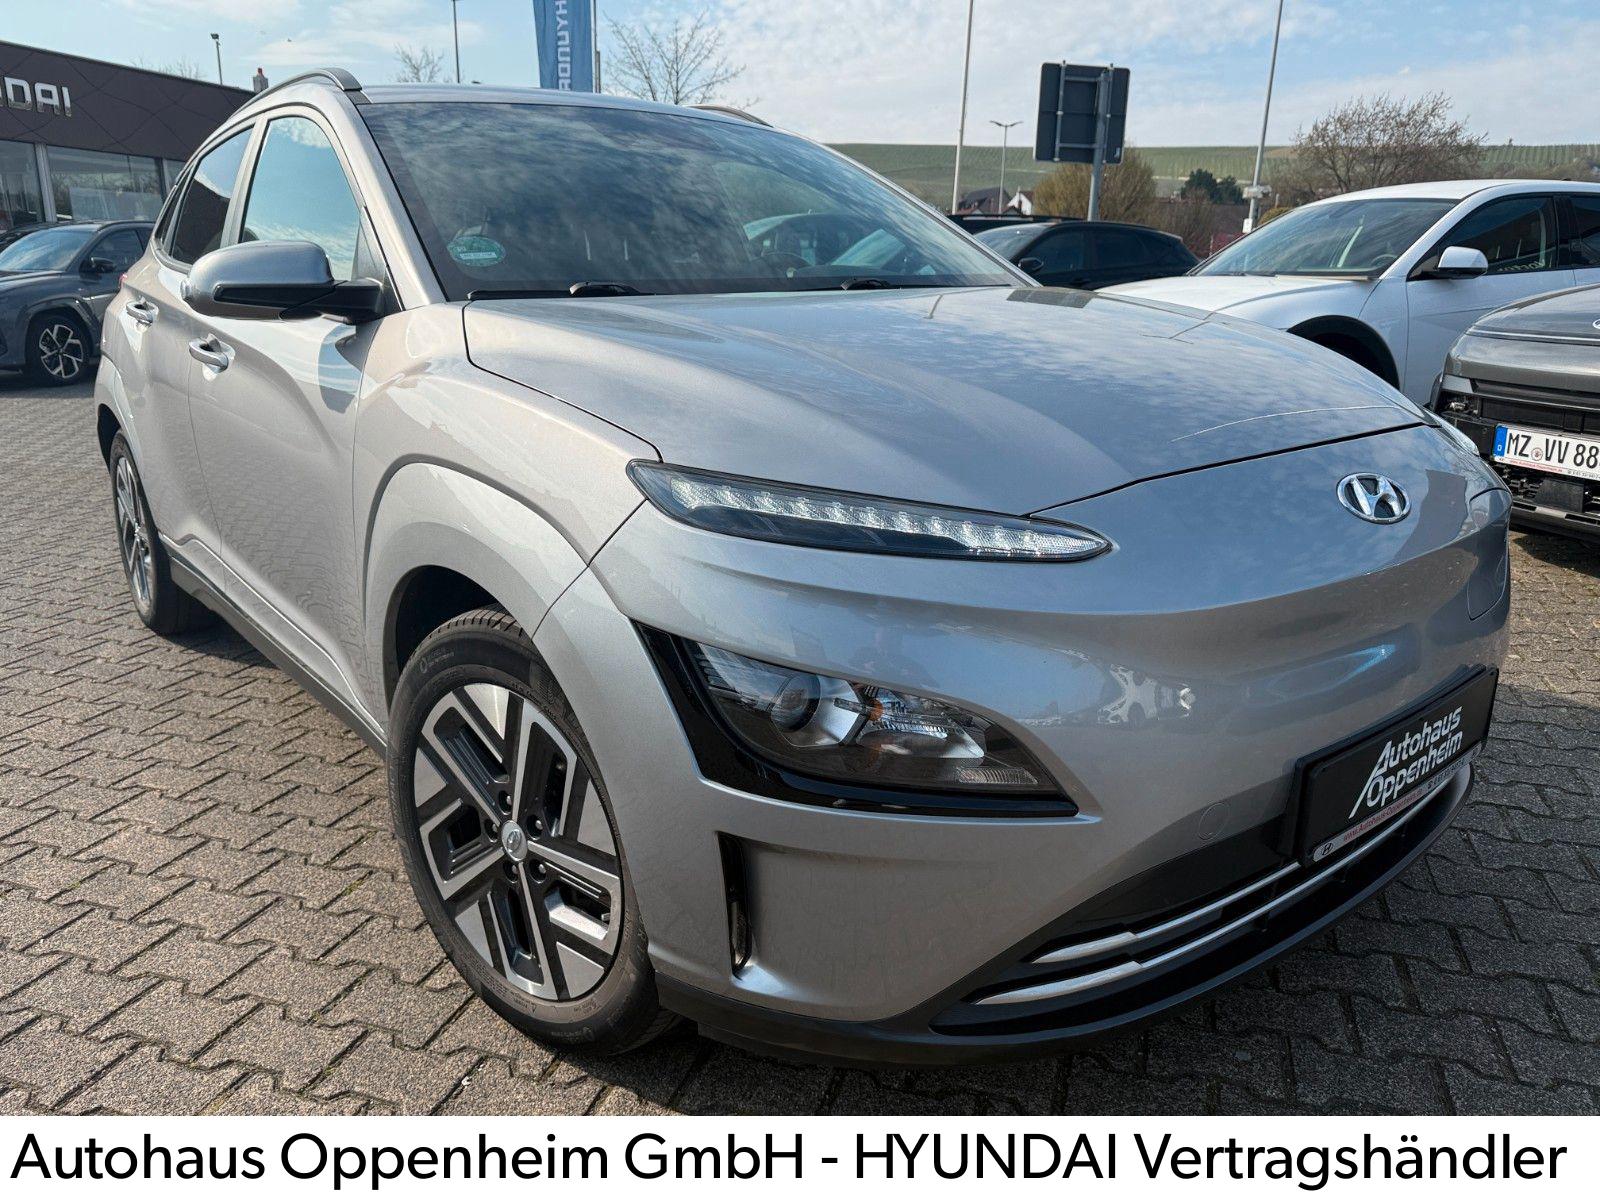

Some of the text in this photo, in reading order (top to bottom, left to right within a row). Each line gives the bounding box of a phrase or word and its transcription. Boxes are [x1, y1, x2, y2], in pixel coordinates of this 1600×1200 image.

[0, 77, 72, 117] DAI
[1506, 432, 1532, 458] MZ
[1545, 438, 1570, 464] VV
[1573, 443, 1600, 469] 88
[1348, 706, 1463, 819] Autohaus
[1366, 731, 1463, 808] Oppenheim
